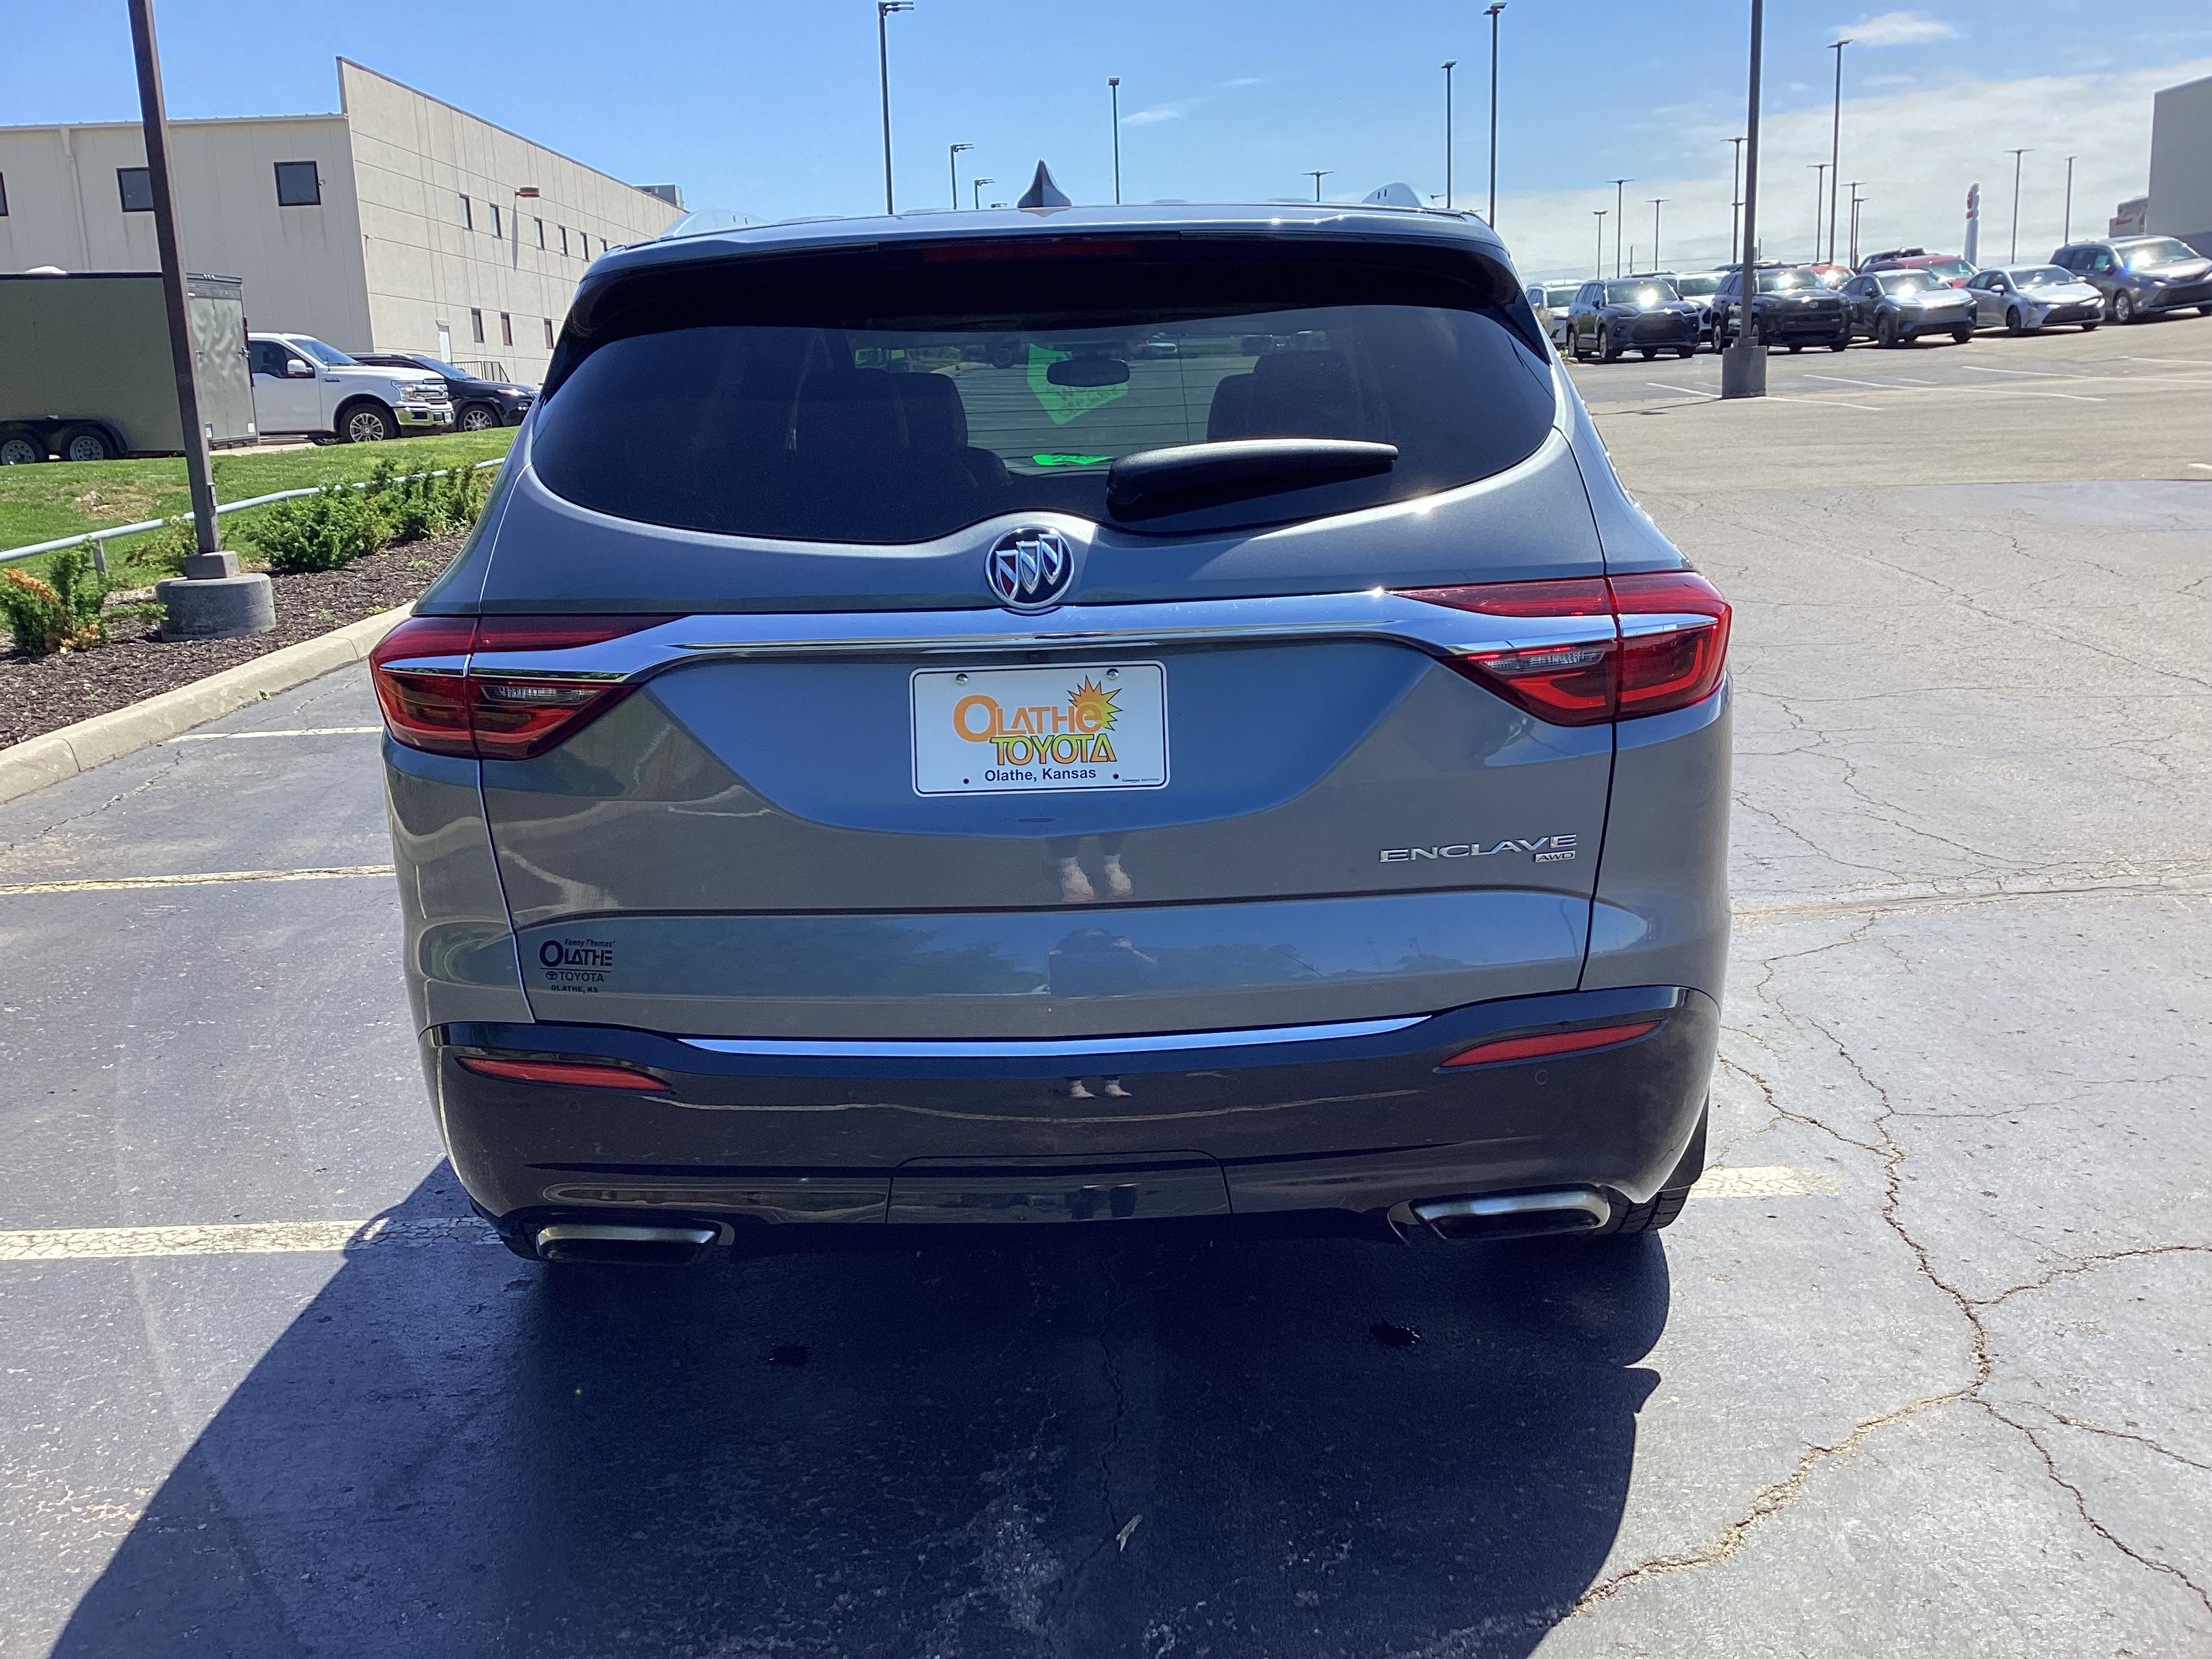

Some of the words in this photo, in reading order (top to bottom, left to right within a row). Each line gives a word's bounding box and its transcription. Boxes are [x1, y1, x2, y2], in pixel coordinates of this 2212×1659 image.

[989, 733, 1117, 766] TOYOTA
[985, 769, 1037, 782] Olathe,
[1042, 767, 1097, 780] Kansas
[1380, 834, 1577, 863] ENCLAVE
[1536, 851, 1574, 861] AWD
[539, 940, 613, 967] OLATHE
[558, 971, 605, 982] TOYOTA
[551, 985, 586, 994] OLATHE,
